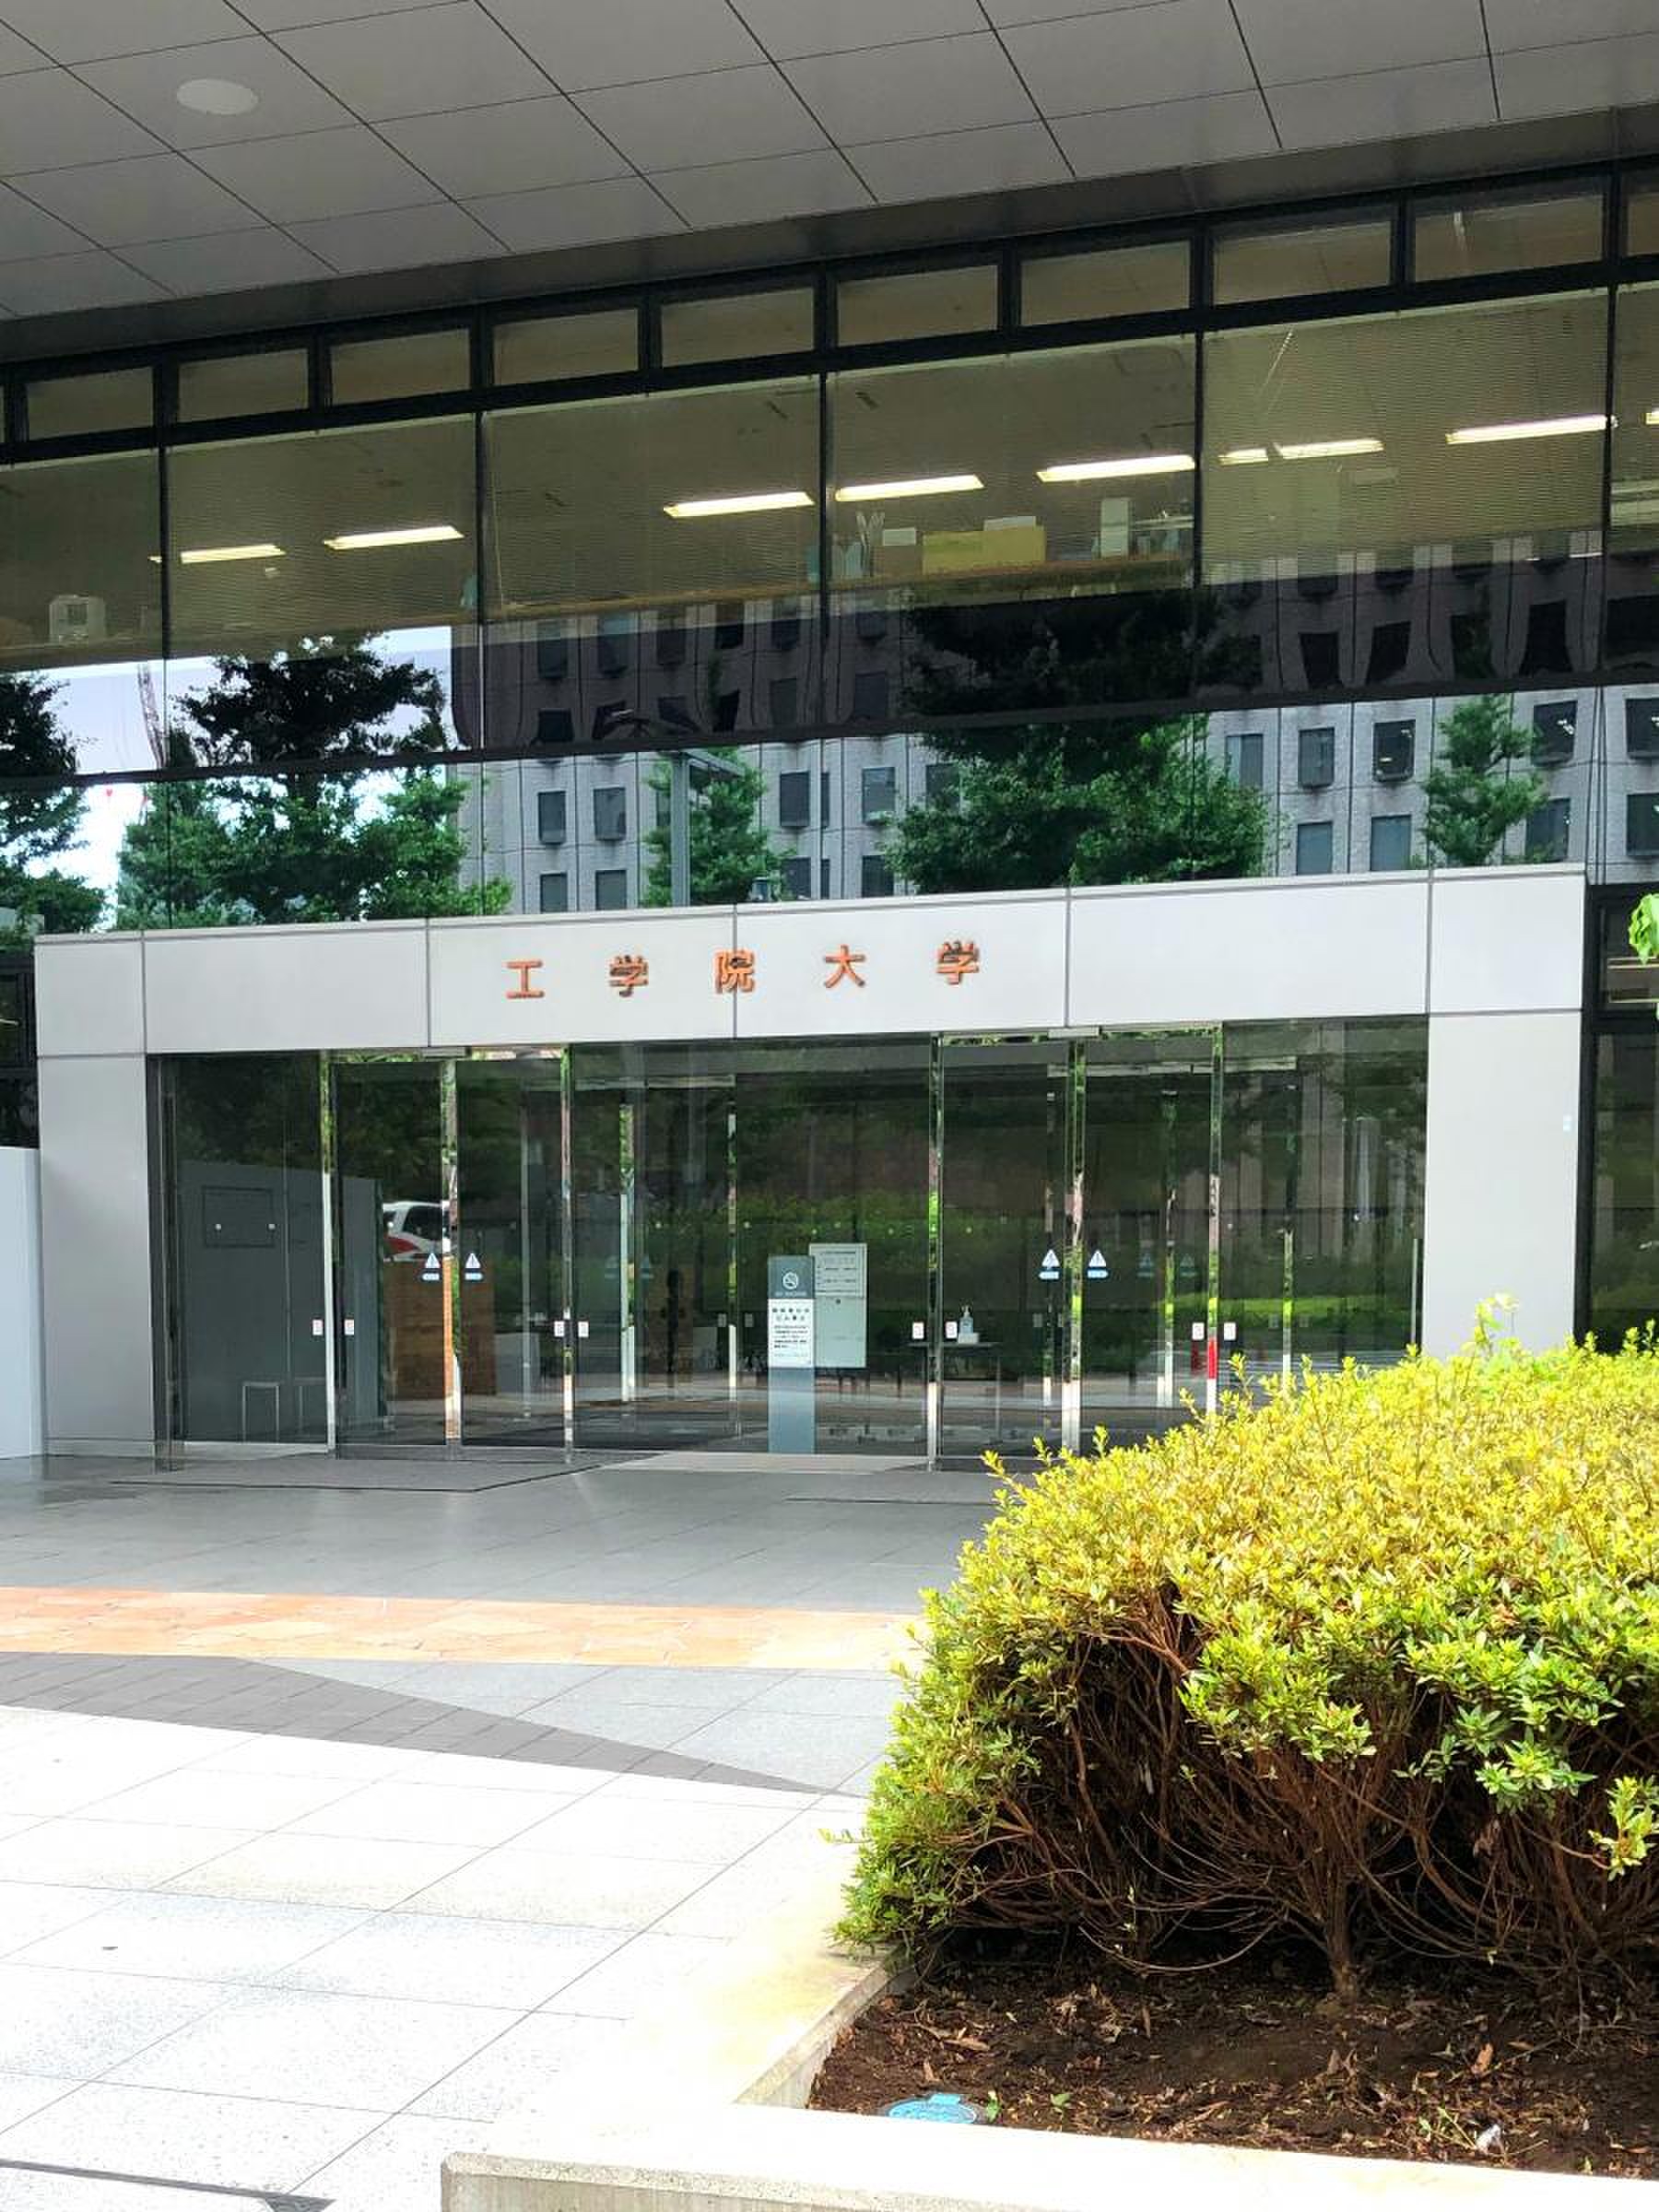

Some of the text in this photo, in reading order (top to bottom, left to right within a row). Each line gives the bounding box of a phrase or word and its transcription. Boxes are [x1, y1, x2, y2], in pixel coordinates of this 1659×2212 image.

[505, 939, 981, 999] 工学院大学
